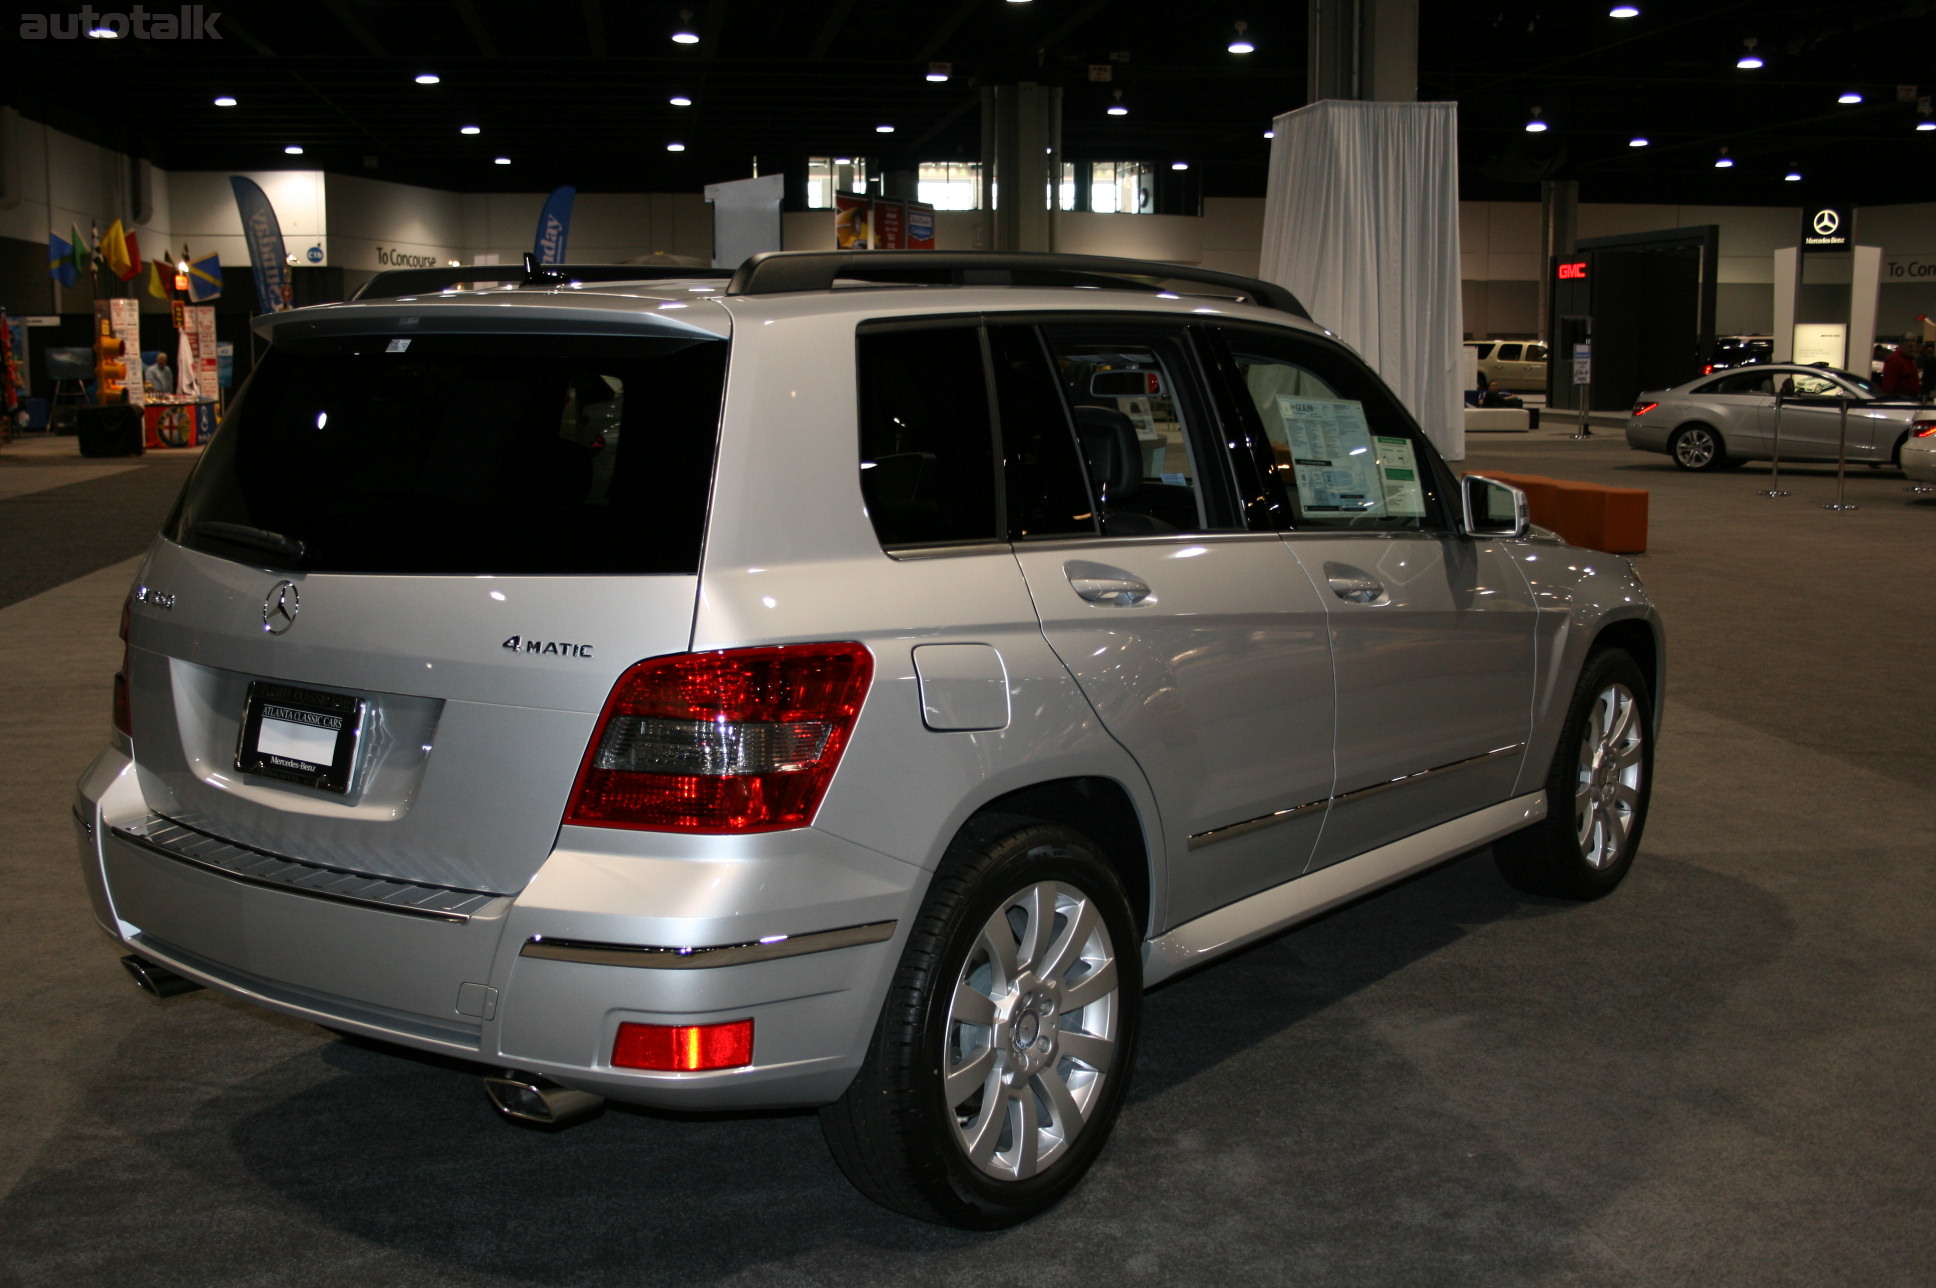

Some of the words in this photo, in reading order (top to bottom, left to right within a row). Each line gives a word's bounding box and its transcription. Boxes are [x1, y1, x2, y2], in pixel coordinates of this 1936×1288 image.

[1805, 236, 1845, 245] Mercedes-Benz
[376, 247, 388, 265] To
[390, 248, 436, 268] Concourse
[1558, 263, 1586, 279] GMC
[1888, 262, 1904, 277] To
[262, 706, 293, 720] ATLANTA
[293, 712, 322, 723] CLASSIC
[323, 717, 342, 729] CARS
[270, 755, 317, 772] Mercedes-Benz
